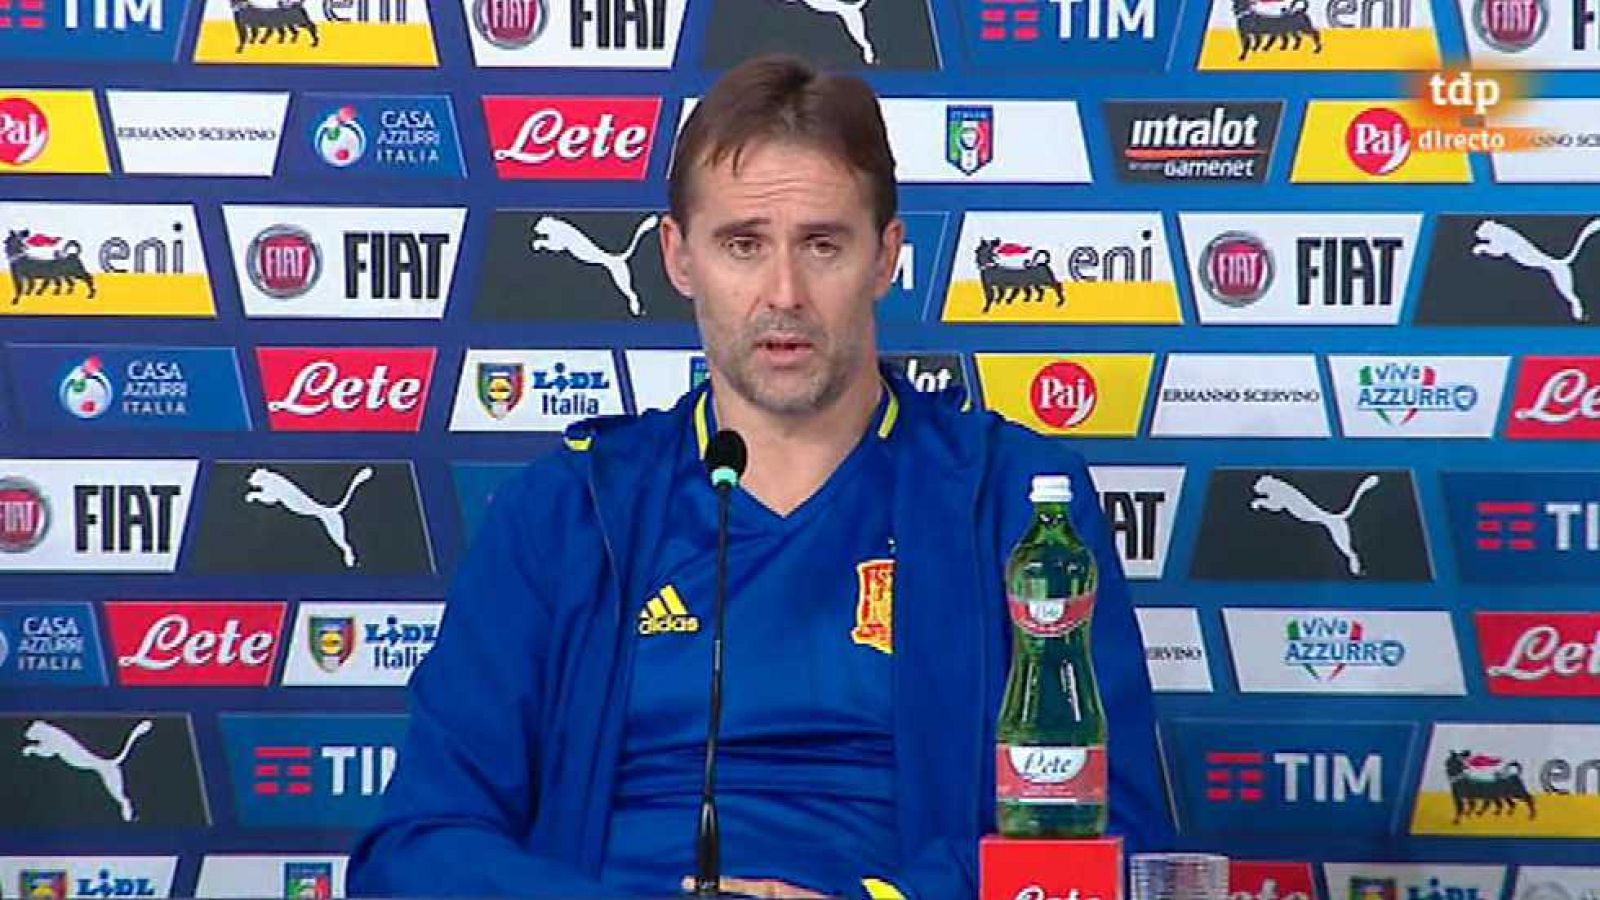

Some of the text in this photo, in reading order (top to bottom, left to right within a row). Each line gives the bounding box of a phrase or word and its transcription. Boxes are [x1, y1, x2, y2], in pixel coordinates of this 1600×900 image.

[1050, 0, 1155, 39] TIM
[381, 109, 435, 128] CASA
[493, 107, 648, 164] Lete
[1131, 107, 1260, 146] intralot
[377, 148, 439, 163] ITALIA
[1354, 122, 1410, 175] Paj
[100, 222, 184, 274] eni
[264, 246, 310, 277] FIAT
[343, 232, 449, 300] FIAT
[1068, 228, 1153, 283] eni
[1218, 252, 1260, 285] FIAT
[1296, 237, 1403, 306] FIAT
[127, 361, 183, 381] CASA
[268, 360, 420, 416] Lete
[122, 400, 187, 416] ITALIA
[541, 395, 600, 416] Italia
[1040, 377, 1096, 426] Paj
[1162, 388, 1321, 403] ERMANNO SCERVINO
[1514, 368, 1600, 423] Le
[73, 484, 181, 553] FIAT
[1102, 491, 1165, 561] AT
[1545, 501, 1600, 551] TI
[23, 616, 79, 635] CASA
[119, 613, 272, 670] Lete
[638, 615, 699, 635] adidas
[18, 655, 83, 670] ITALIA
[1273, 753, 1383, 803] TIM
[1540, 758, 1600, 794] en
